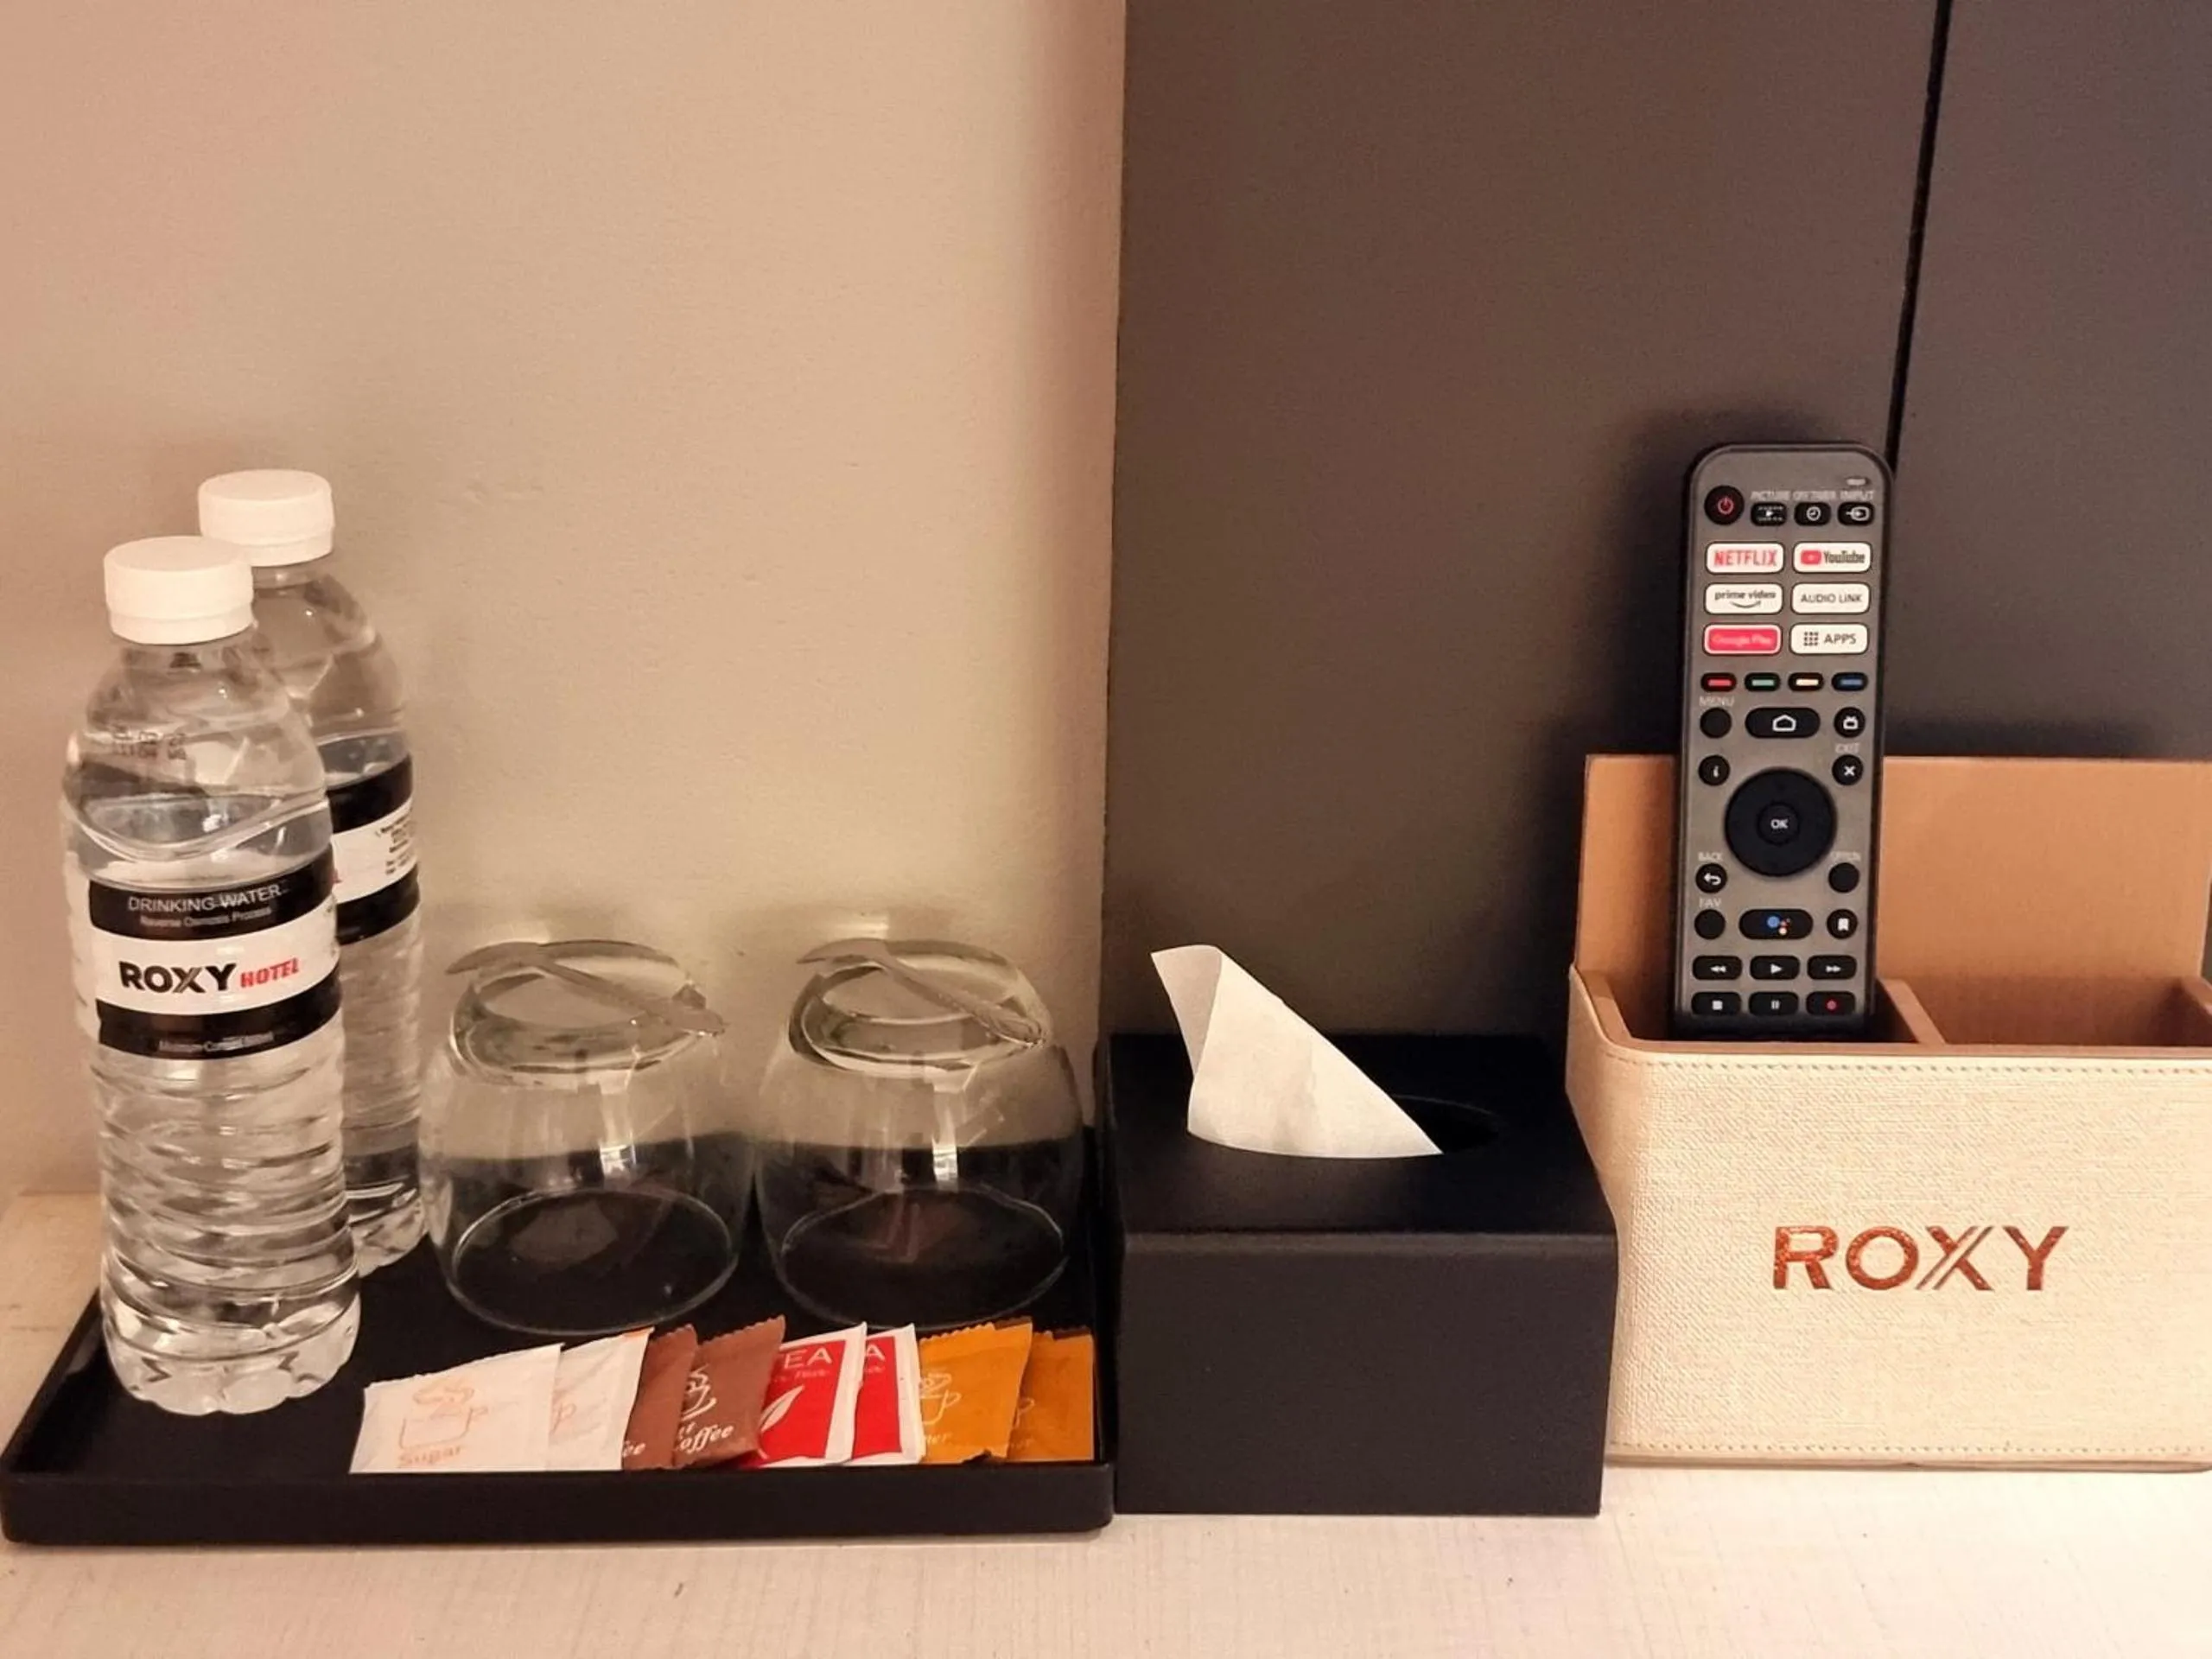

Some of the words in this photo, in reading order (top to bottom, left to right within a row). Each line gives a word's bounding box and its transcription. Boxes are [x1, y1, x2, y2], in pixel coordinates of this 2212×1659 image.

[1714, 549, 1777, 567] NETFLIX
[1823, 550, 1866, 564] YouTube
[1714, 589, 1745, 601] prime
[1748, 589, 1777, 599] video
[1800, 594, 1836, 604] AUDIO
[1839, 593, 1862, 603] LINK
[1824, 632, 1857, 645] APPS
[1700, 696, 1734, 706] MENU
[1770, 818, 1789, 830] OK
[129, 895, 215, 913] DRINKING
[219, 884, 282, 908] WATER
[1699, 898, 1722, 907] FAV
[118, 961, 237, 994] ROXY
[240, 957, 300, 988] HOTEL
[1773, 1225, 2069, 1290] ROXY
[780, 1347, 833, 1370] EA
[677, 1424, 734, 1454] offee
